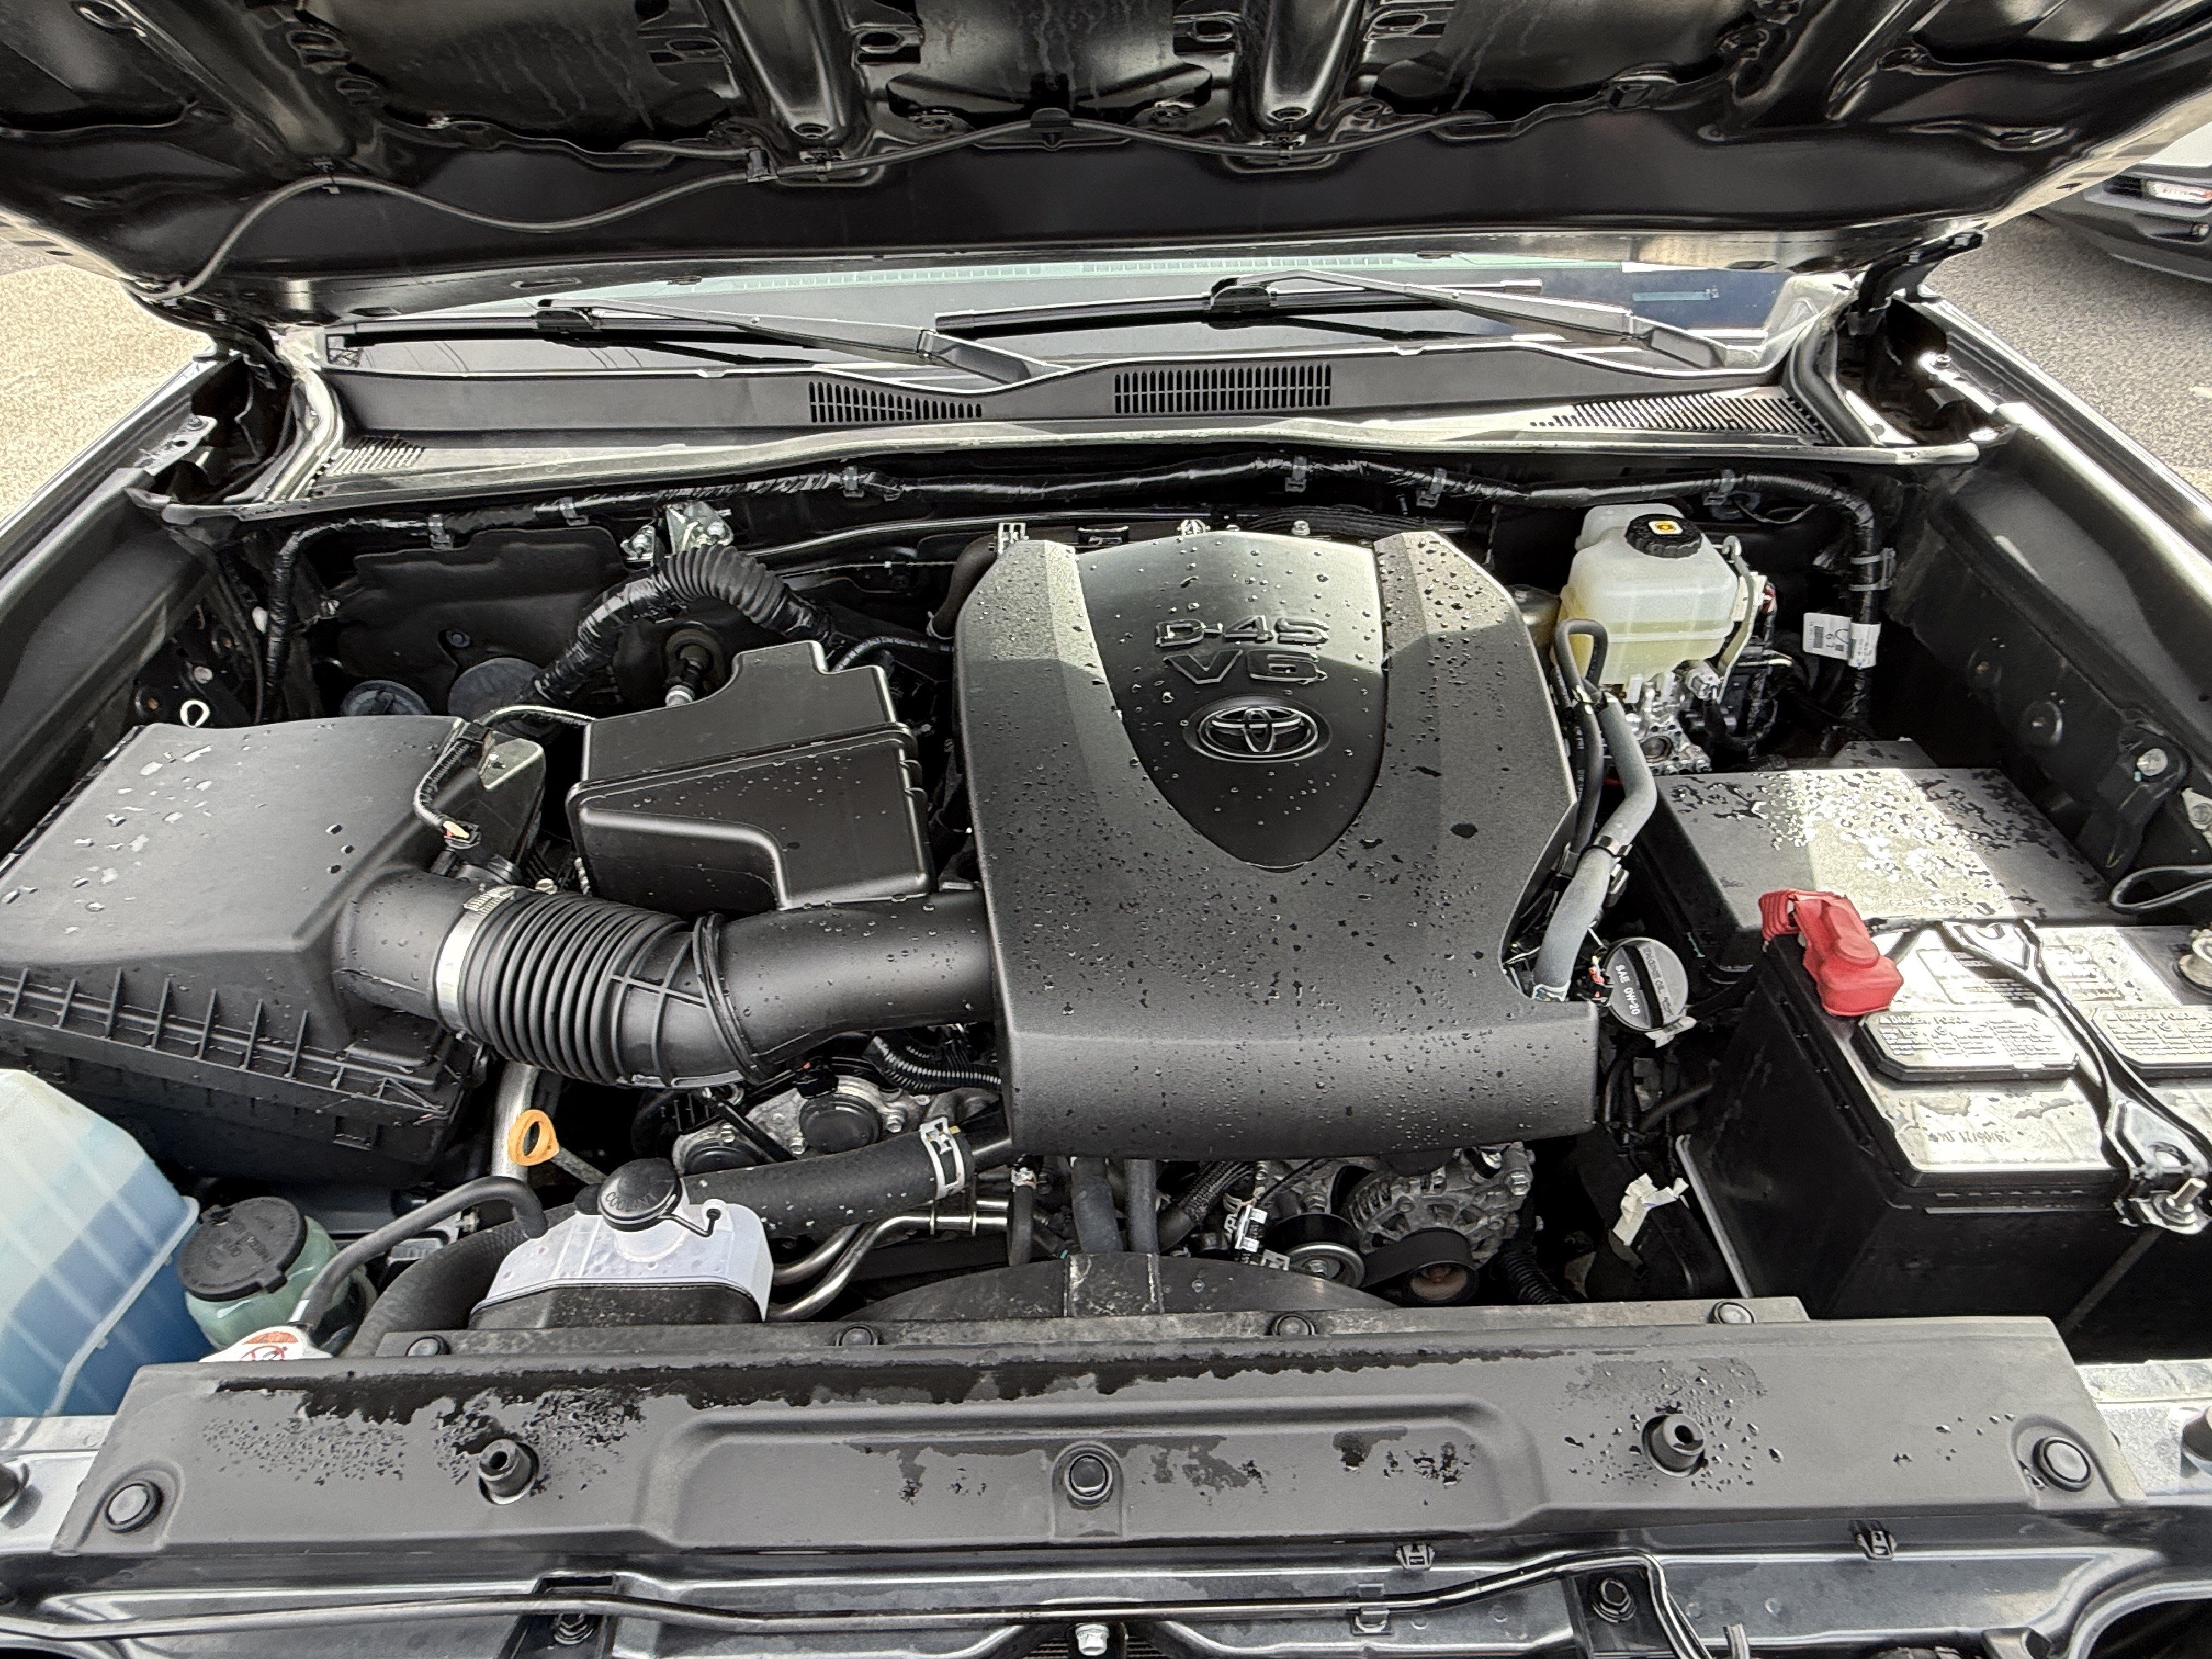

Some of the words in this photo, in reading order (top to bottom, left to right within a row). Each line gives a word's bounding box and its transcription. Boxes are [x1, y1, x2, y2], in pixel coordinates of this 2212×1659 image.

[1155, 615, 1329, 646] D-4S
[1163, 649, 1322, 684] V6
[1615, 964, 1630, 984] SAE
[1623, 987, 1640, 1015] 0W-20
